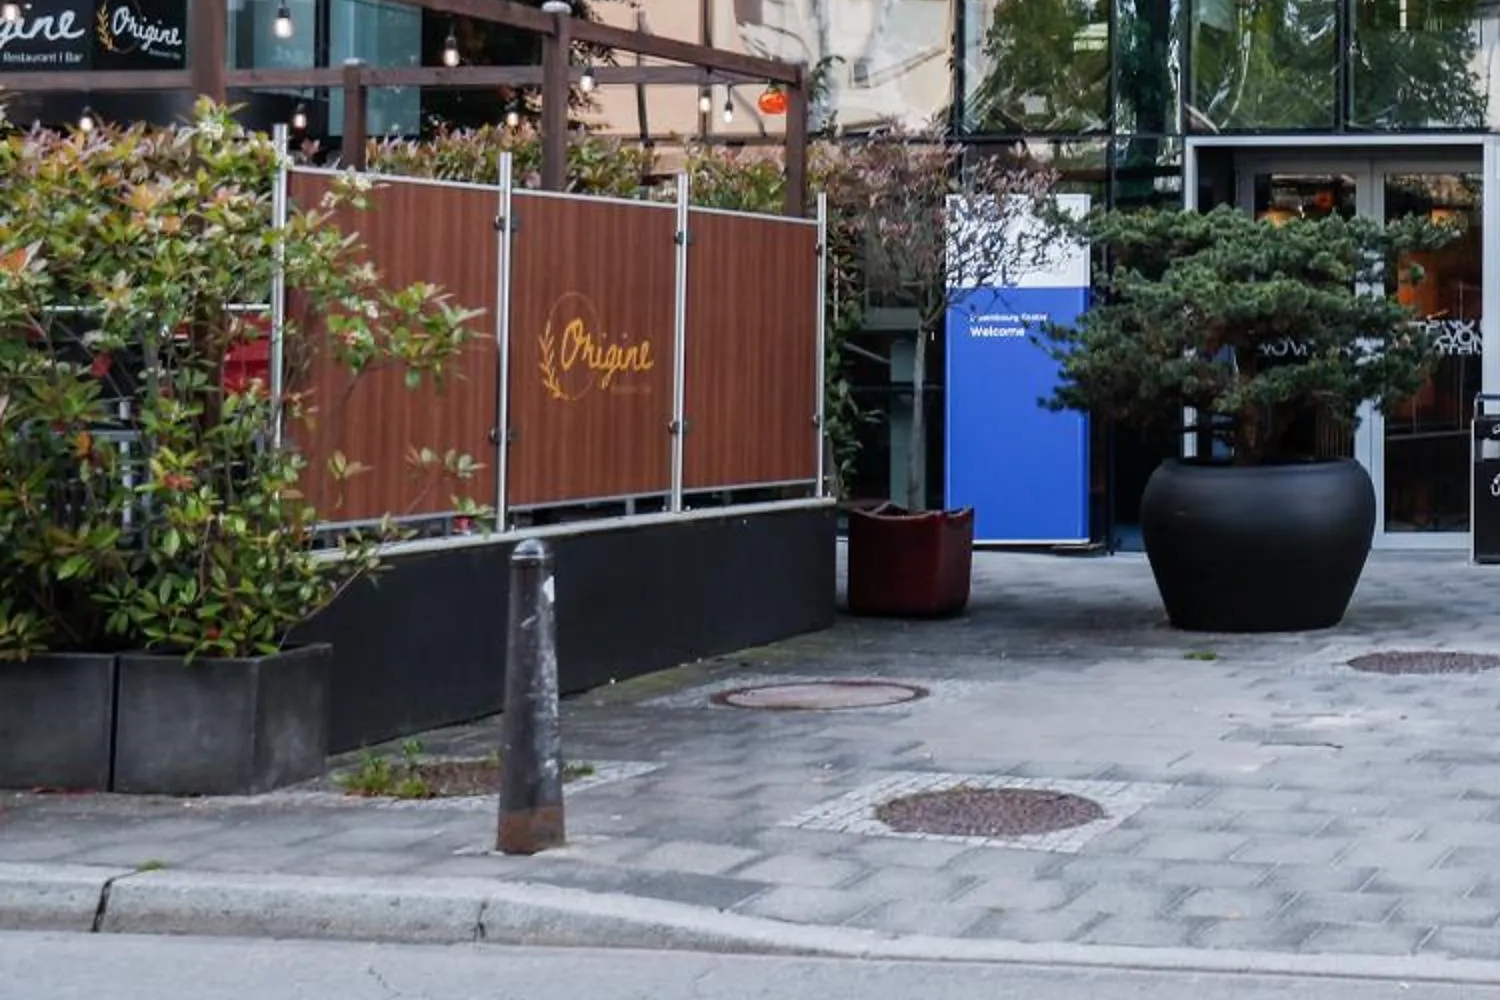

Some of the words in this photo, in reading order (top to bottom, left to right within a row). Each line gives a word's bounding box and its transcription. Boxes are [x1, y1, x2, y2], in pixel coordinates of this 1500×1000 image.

[112, 5, 183, 51] Origine
[3, 51, 57, 63] Restaurant
[65, 51, 84, 63] Bar
[561, 317, 655, 390] Origine
